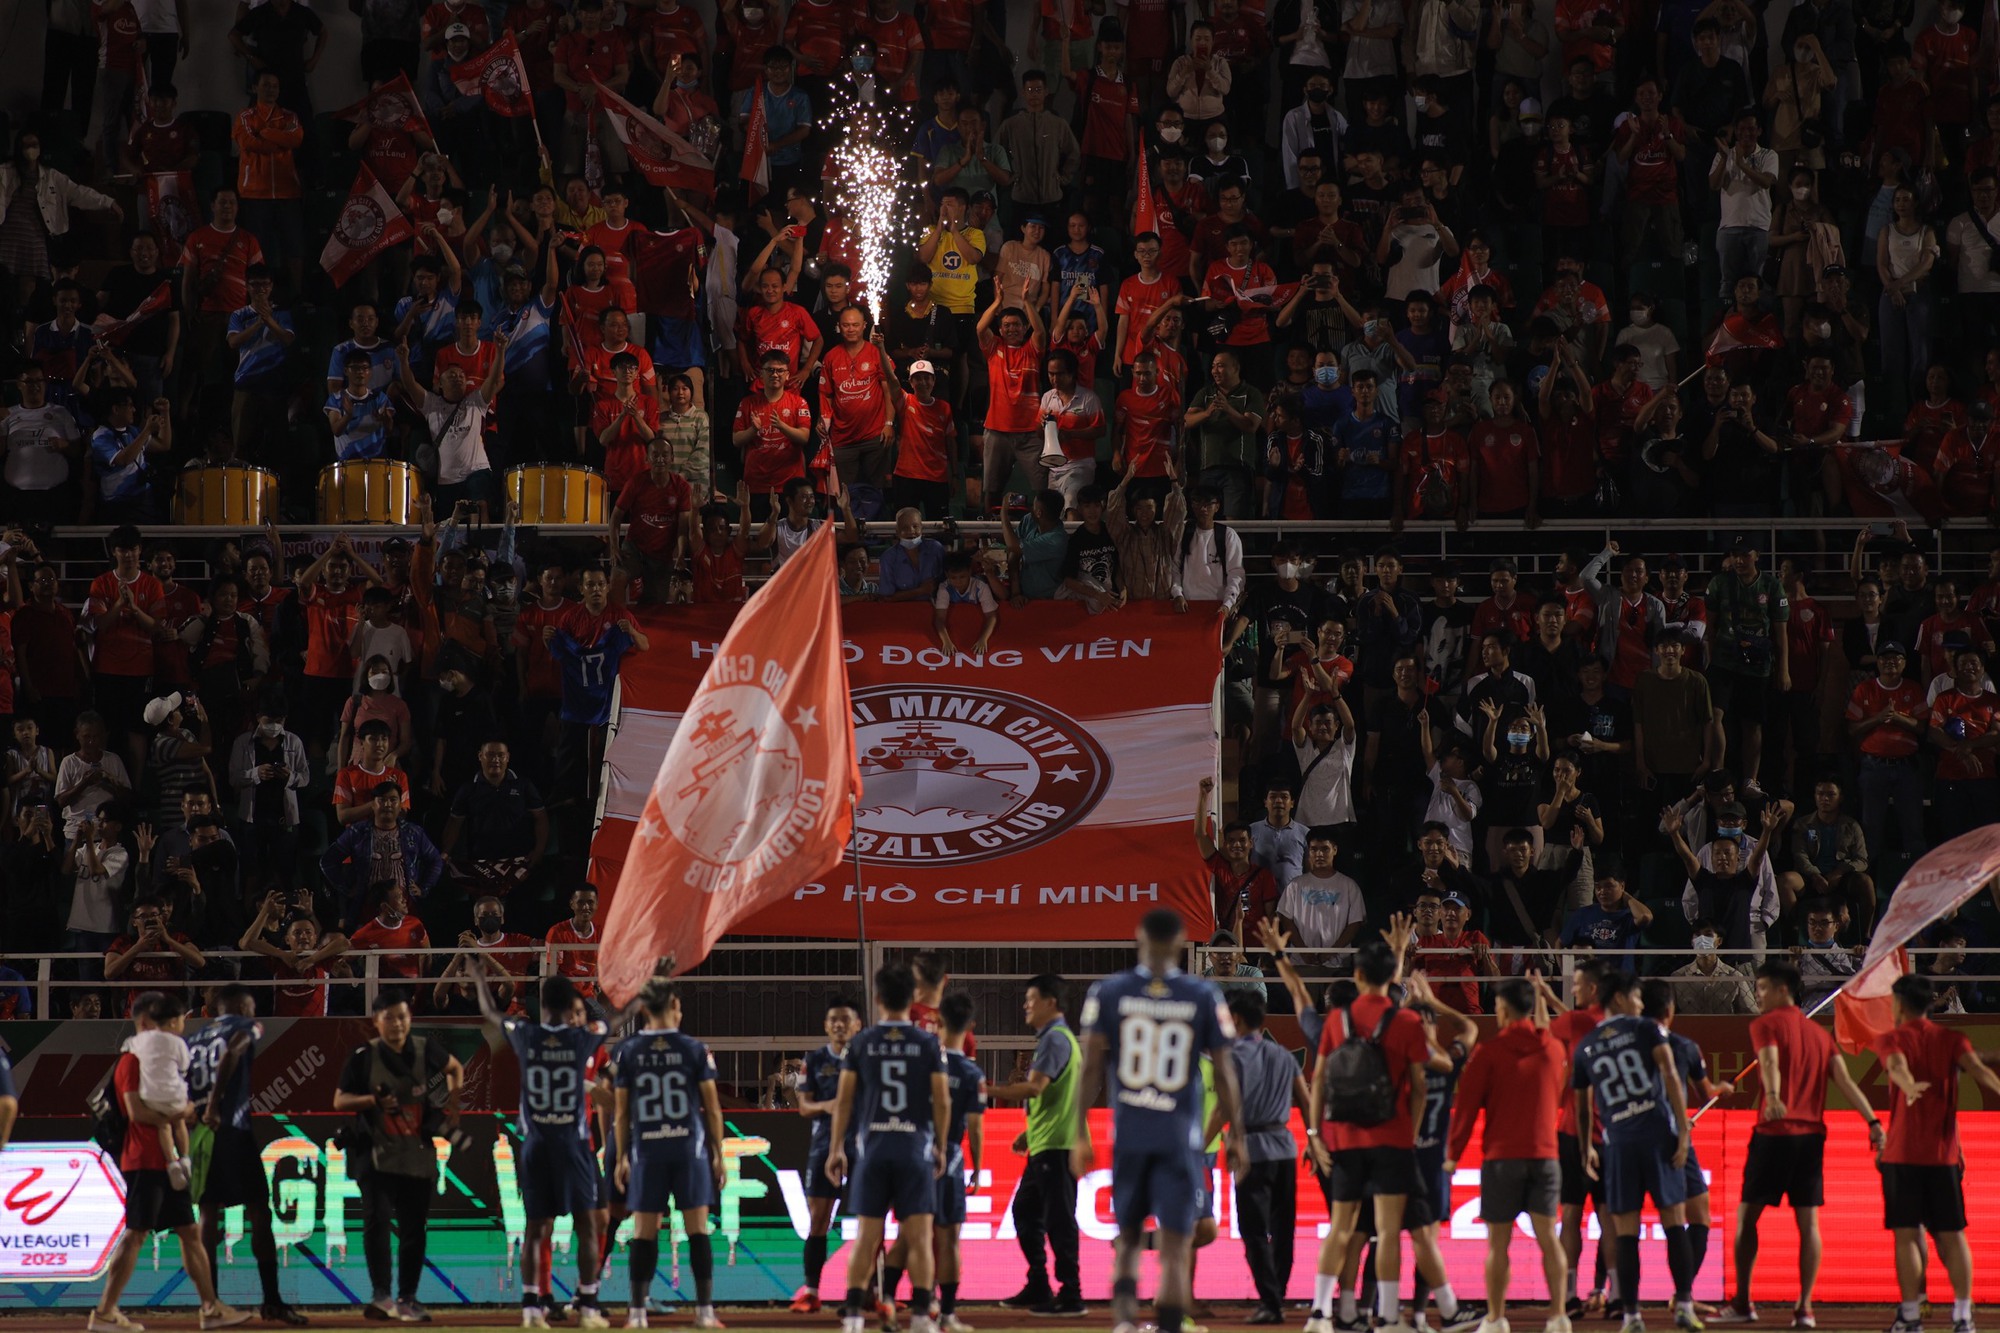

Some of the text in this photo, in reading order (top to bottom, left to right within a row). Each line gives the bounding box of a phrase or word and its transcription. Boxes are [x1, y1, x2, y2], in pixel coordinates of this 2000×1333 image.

[944, 255, 960, 267] XT
[1736, 535, 1744, 545] P
[580, 652, 605, 687] 17
[841, 637, 1153, 672] Ổ ĐỘNG VIÊN
[889, 695, 1006, 726] MINH
[1004, 716, 1080, 760] CITY
[845, 800, 1066, 857] BALL CLUB
[842, 883, 917, 903] HỒ
[934, 883, 1023, 904] CHÍ
[1039, 882, 1159, 904] MINH
[1118, 1015, 1195, 1091] 88
[250, 1044, 326, 1115] ĂNG LỰC
[527, 1065, 577, 1112] 92
[635, 1072, 690, 1122] 26
[880, 1059, 908, 1113] 5
[1592, 1048, 1653, 1107] 28
[21, 1252, 68, 1266] 2023
